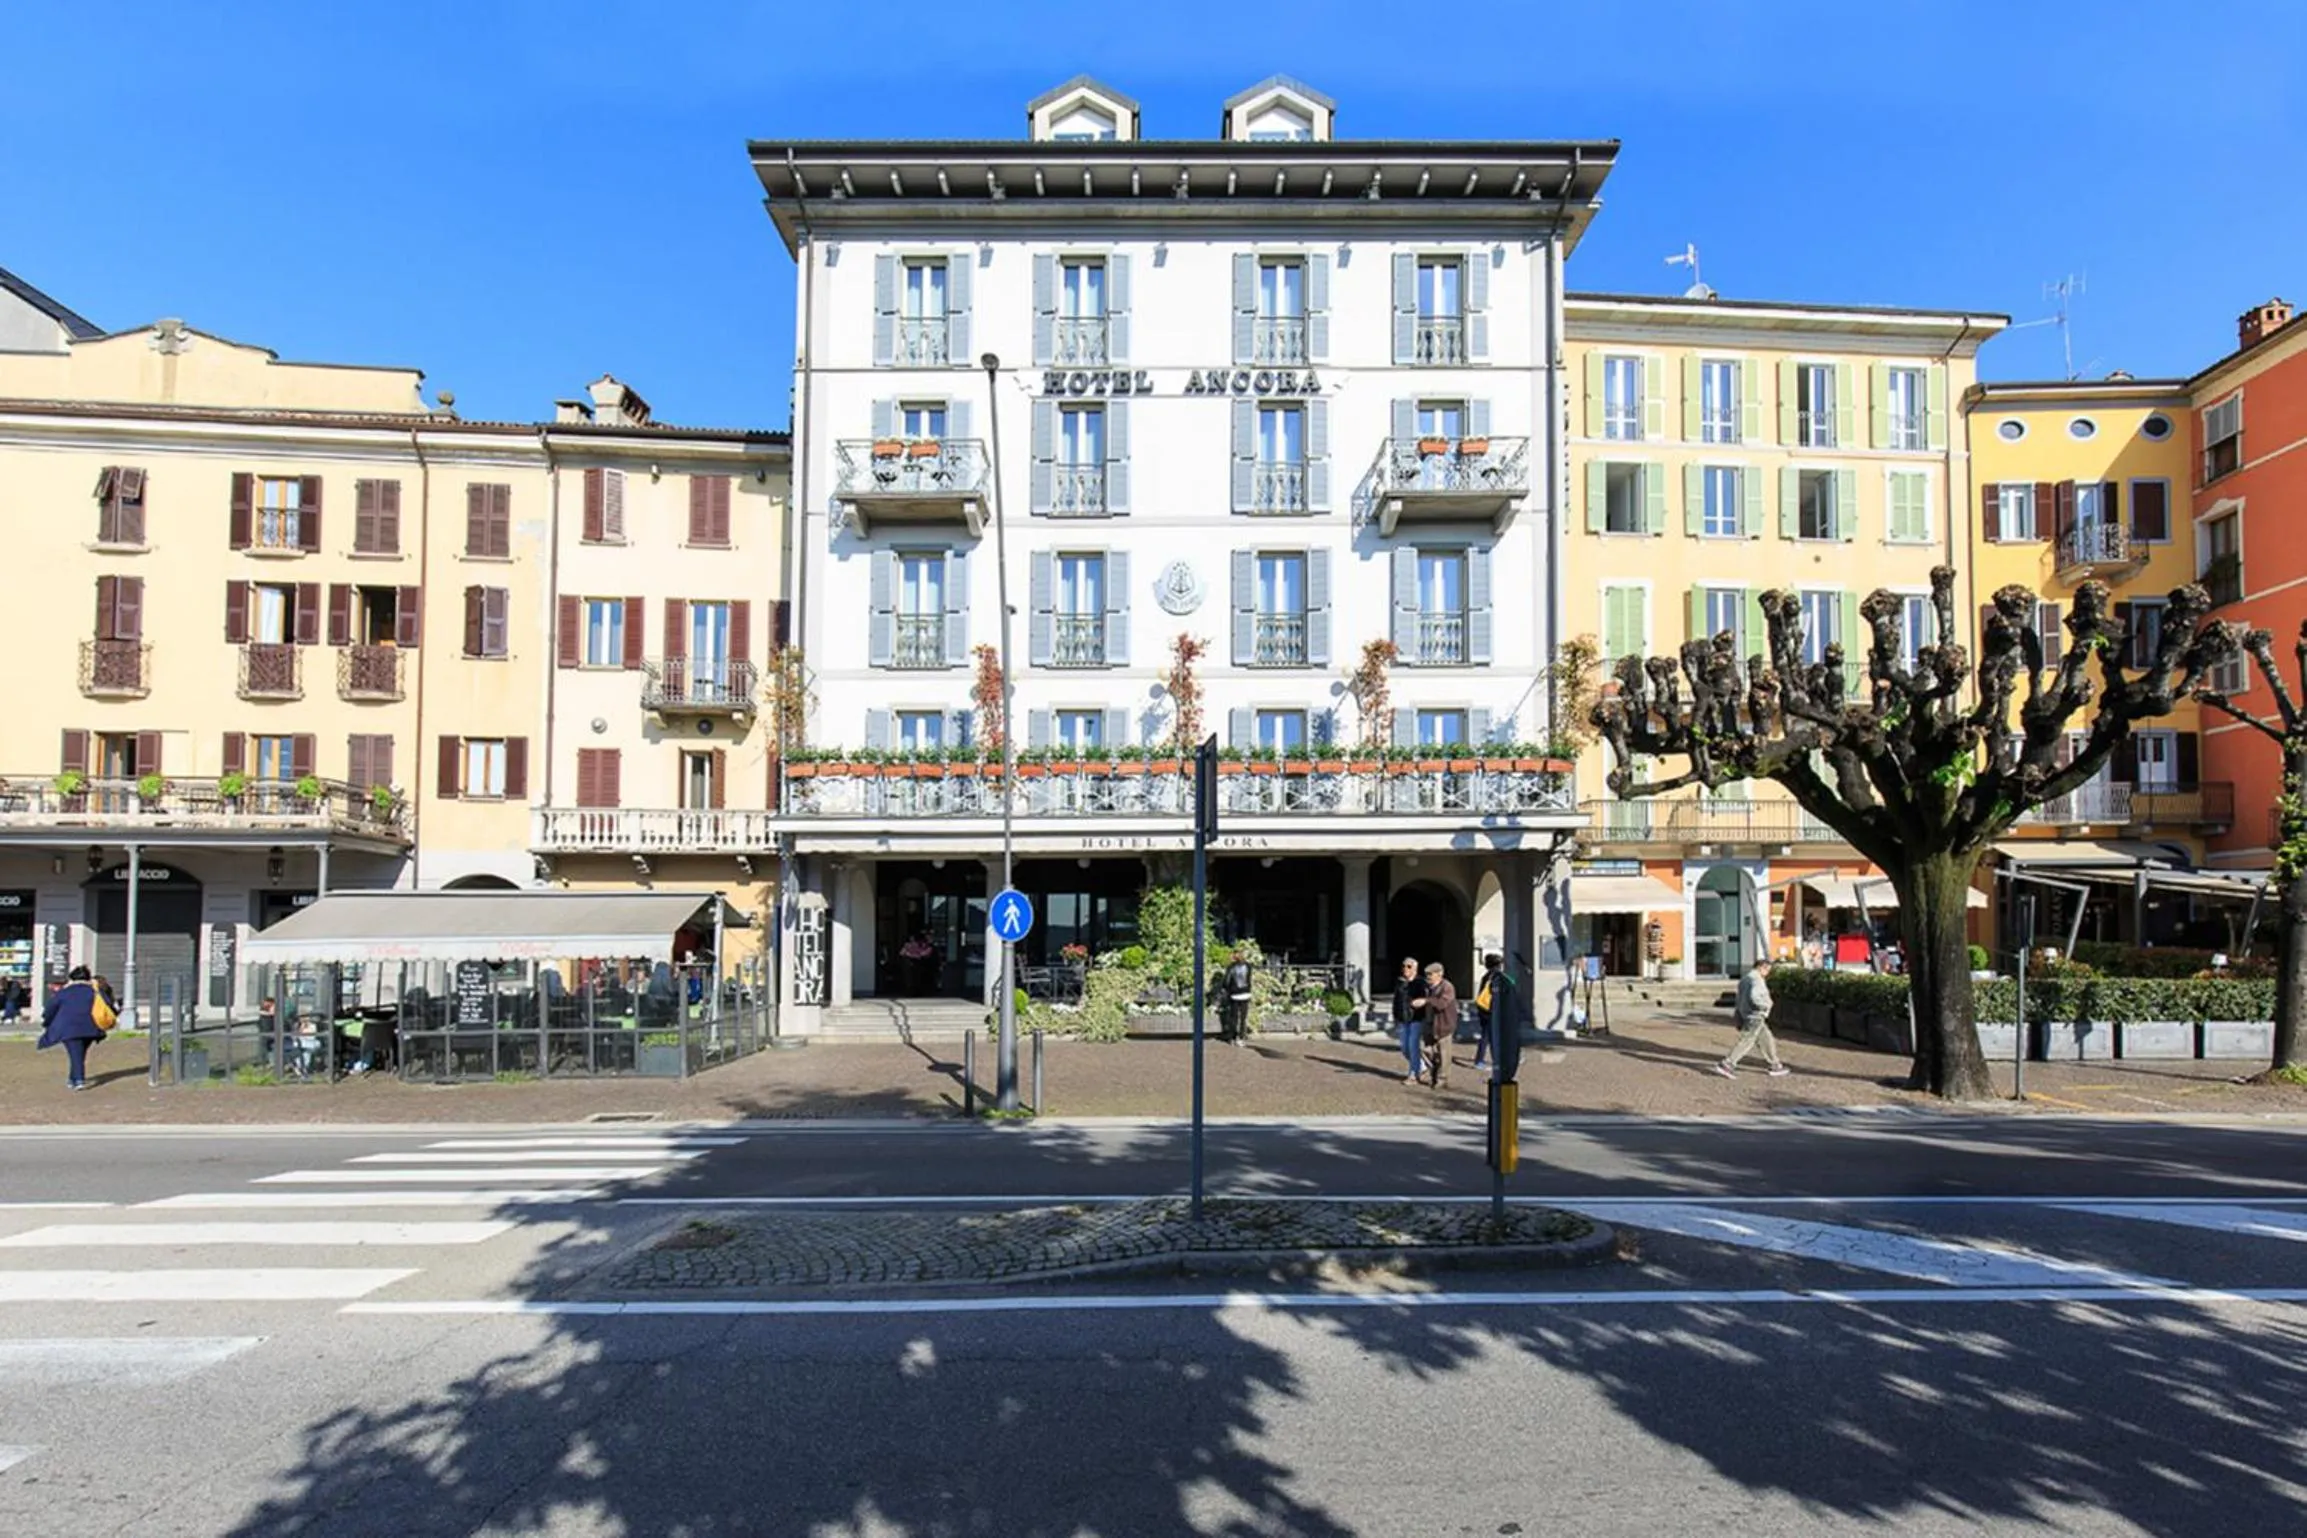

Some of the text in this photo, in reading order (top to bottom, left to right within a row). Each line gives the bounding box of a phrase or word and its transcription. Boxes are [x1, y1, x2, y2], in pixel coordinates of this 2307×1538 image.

[1043, 370, 1322, 396] HOTEL ANCORA
[1082, 837, 1269, 849] HOTEL AORA
